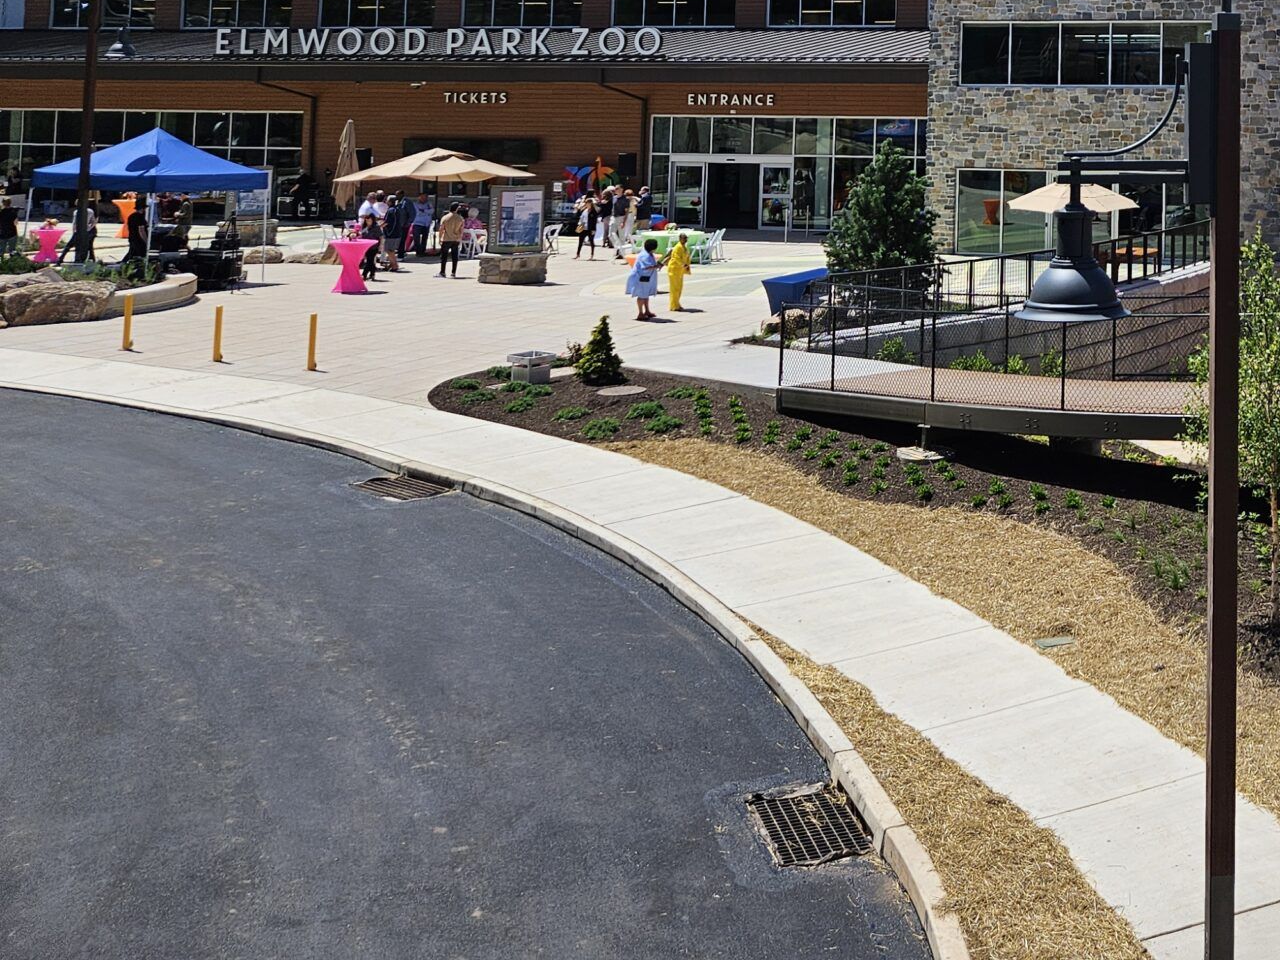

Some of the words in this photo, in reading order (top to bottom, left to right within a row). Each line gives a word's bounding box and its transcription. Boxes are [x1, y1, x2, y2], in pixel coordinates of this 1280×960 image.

[215, 27, 426, 55] ELMWOOD
[446, 27, 550, 55] PARK
[571, 27, 661, 56] ZOO
[443, 92, 508, 104] TICKETS
[687, 93, 775, 106] ENTRANCE
